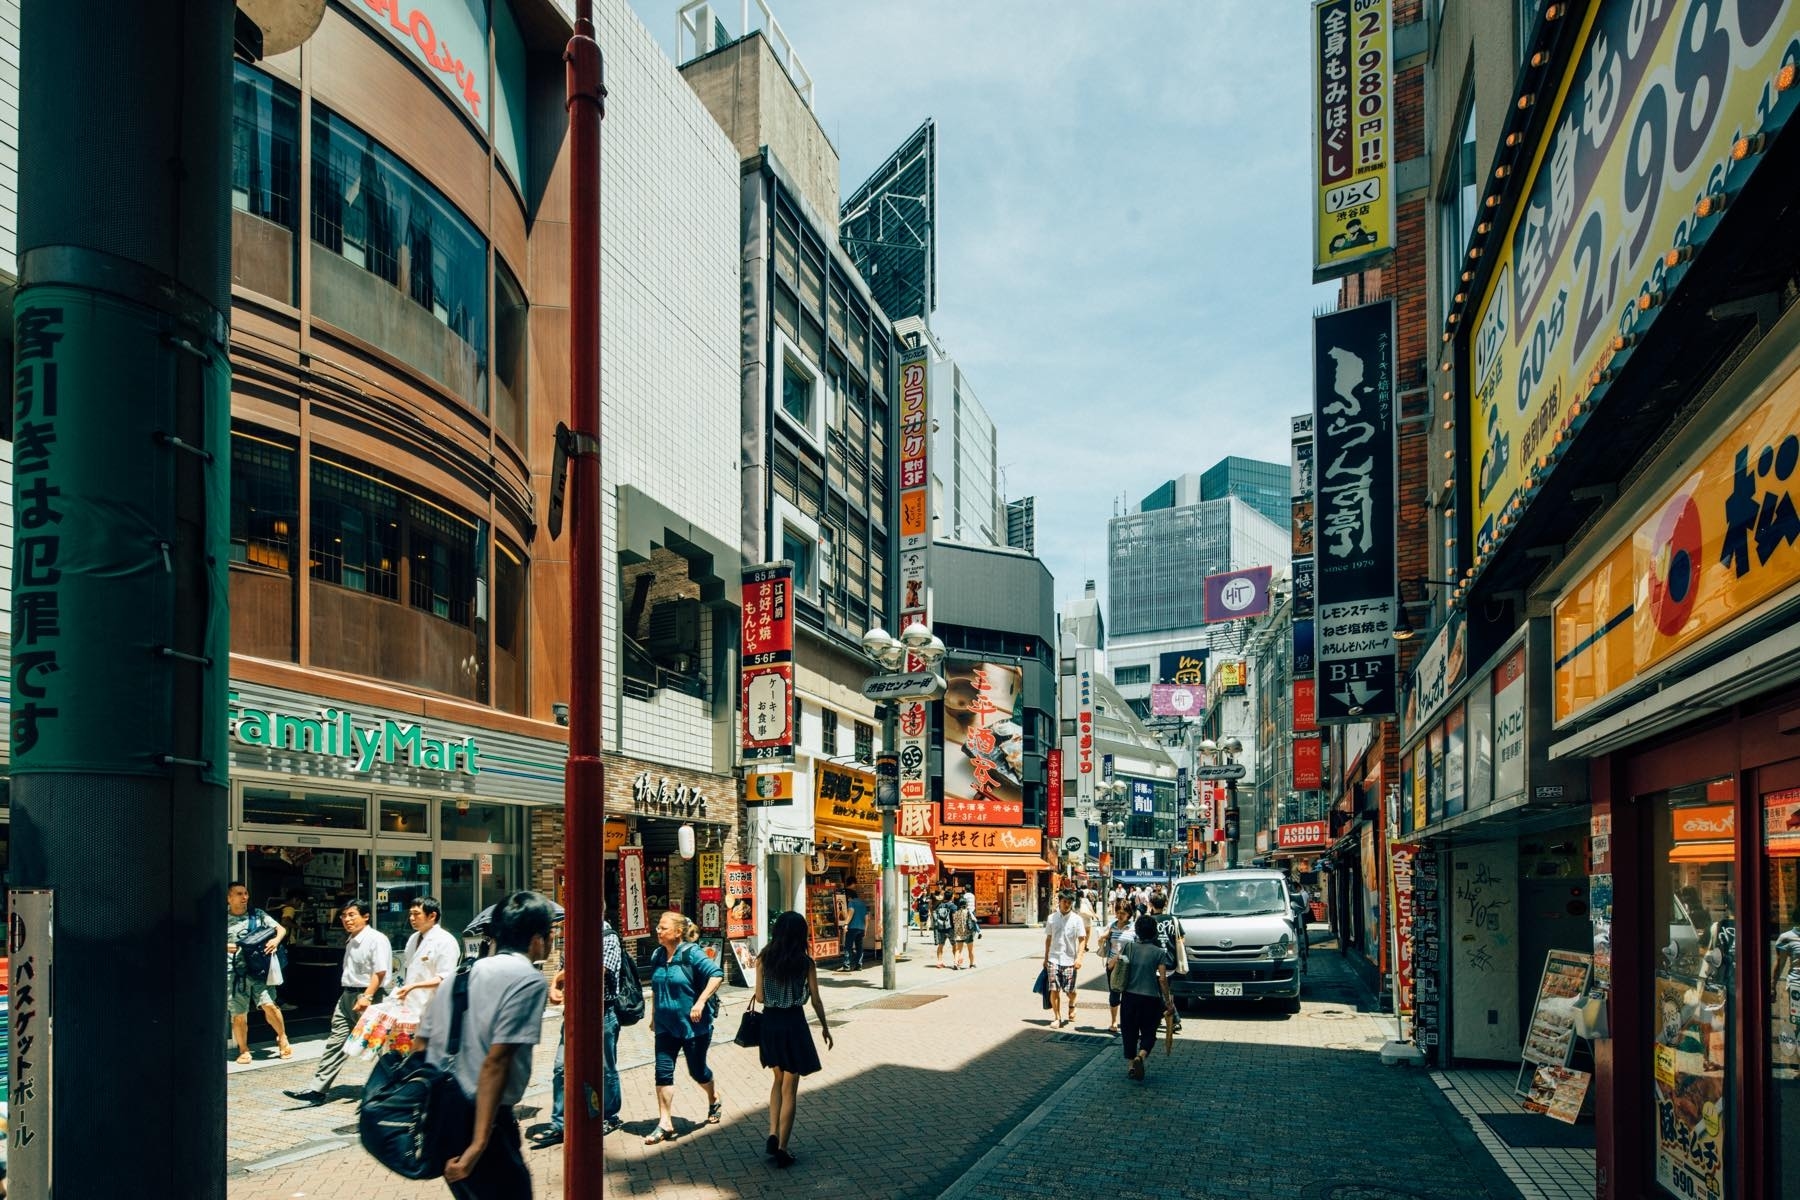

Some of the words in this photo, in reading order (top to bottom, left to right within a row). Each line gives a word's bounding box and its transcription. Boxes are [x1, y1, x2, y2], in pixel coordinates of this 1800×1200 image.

[1324, 8, 1347, 177] 全身もみほぐし
[1332, 182, 1374, 210] りらく
[1337, 204, 1370, 222] 渋谷店
[1477, 280, 1508, 384] りらく
[1517, 286, 1568, 412] 60分
[1377, 331, 1389, 432] ステーキと焙煎カレー
[903, 364, 926, 457] カラオケ
[904, 459, 924, 473] 受付
[1320, 345, 1375, 559] ふらんす亭
[904, 470, 924, 486] 3F
[12, 305, 65, 757] 客引きは犯罪です
[908, 537, 919, 546] 2F
[1323, 563, 1349, 573] since
[758, 583, 772, 641] お好み焼
[774, 583, 784, 619] 江戸前
[1322, 602, 1390, 620] レモンステーキ
[744, 601, 757, 653] もんじゃ
[1322, 620, 1388, 638] ねぎ塩焼き
[1322, 638, 1390, 655] おろししそハンバーグ
[865, 677, 934, 693] 渋谷センター街
[1329, 660, 1383, 681] B1F
[768, 678, 777, 722] ケーキと
[757, 701, 767, 737] お食事
[1298, 747, 1317, 756] FK
[1134, 795, 1153, 812] 青山
[900, 803, 932, 836] 豚
[935, 830, 998, 848] 沖縄そば
[1220, 987, 1241, 995] 22-77
[14, 956, 36, 1150] バスケットボール
[1672, 1165, 1694, 1199] 590
